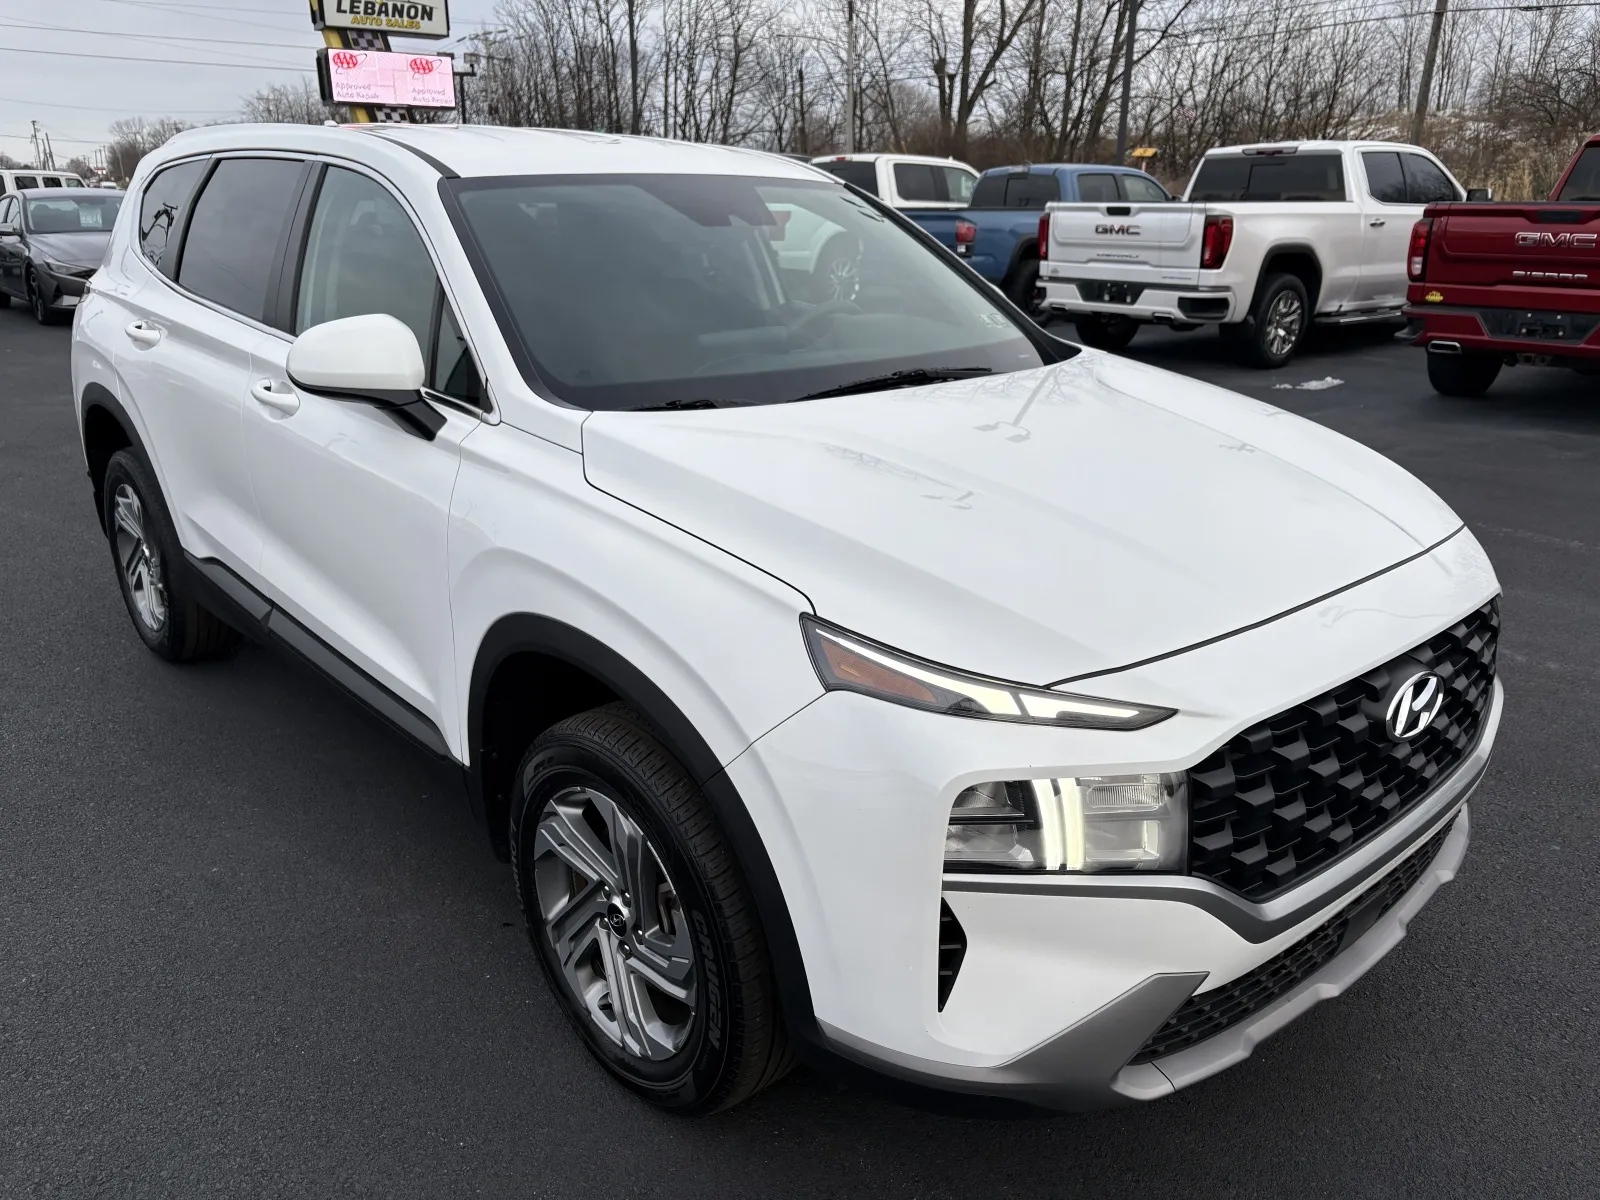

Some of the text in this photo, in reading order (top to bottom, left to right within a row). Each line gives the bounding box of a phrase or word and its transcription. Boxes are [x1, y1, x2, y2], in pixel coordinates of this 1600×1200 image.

[336, 0, 434, 21] LEBANON
[351, 15, 421, 29] AUTO SALES
[333, 52, 358, 69] AAA
[410, 58, 434, 74] AAA
[336, 82, 371, 91] Approved
[337, 91, 355, 99] Auto
[1095, 225, 1141, 235] GMC
[1515, 232, 1597, 248] GMC
[692, 909, 722, 1050] CRUGEN
